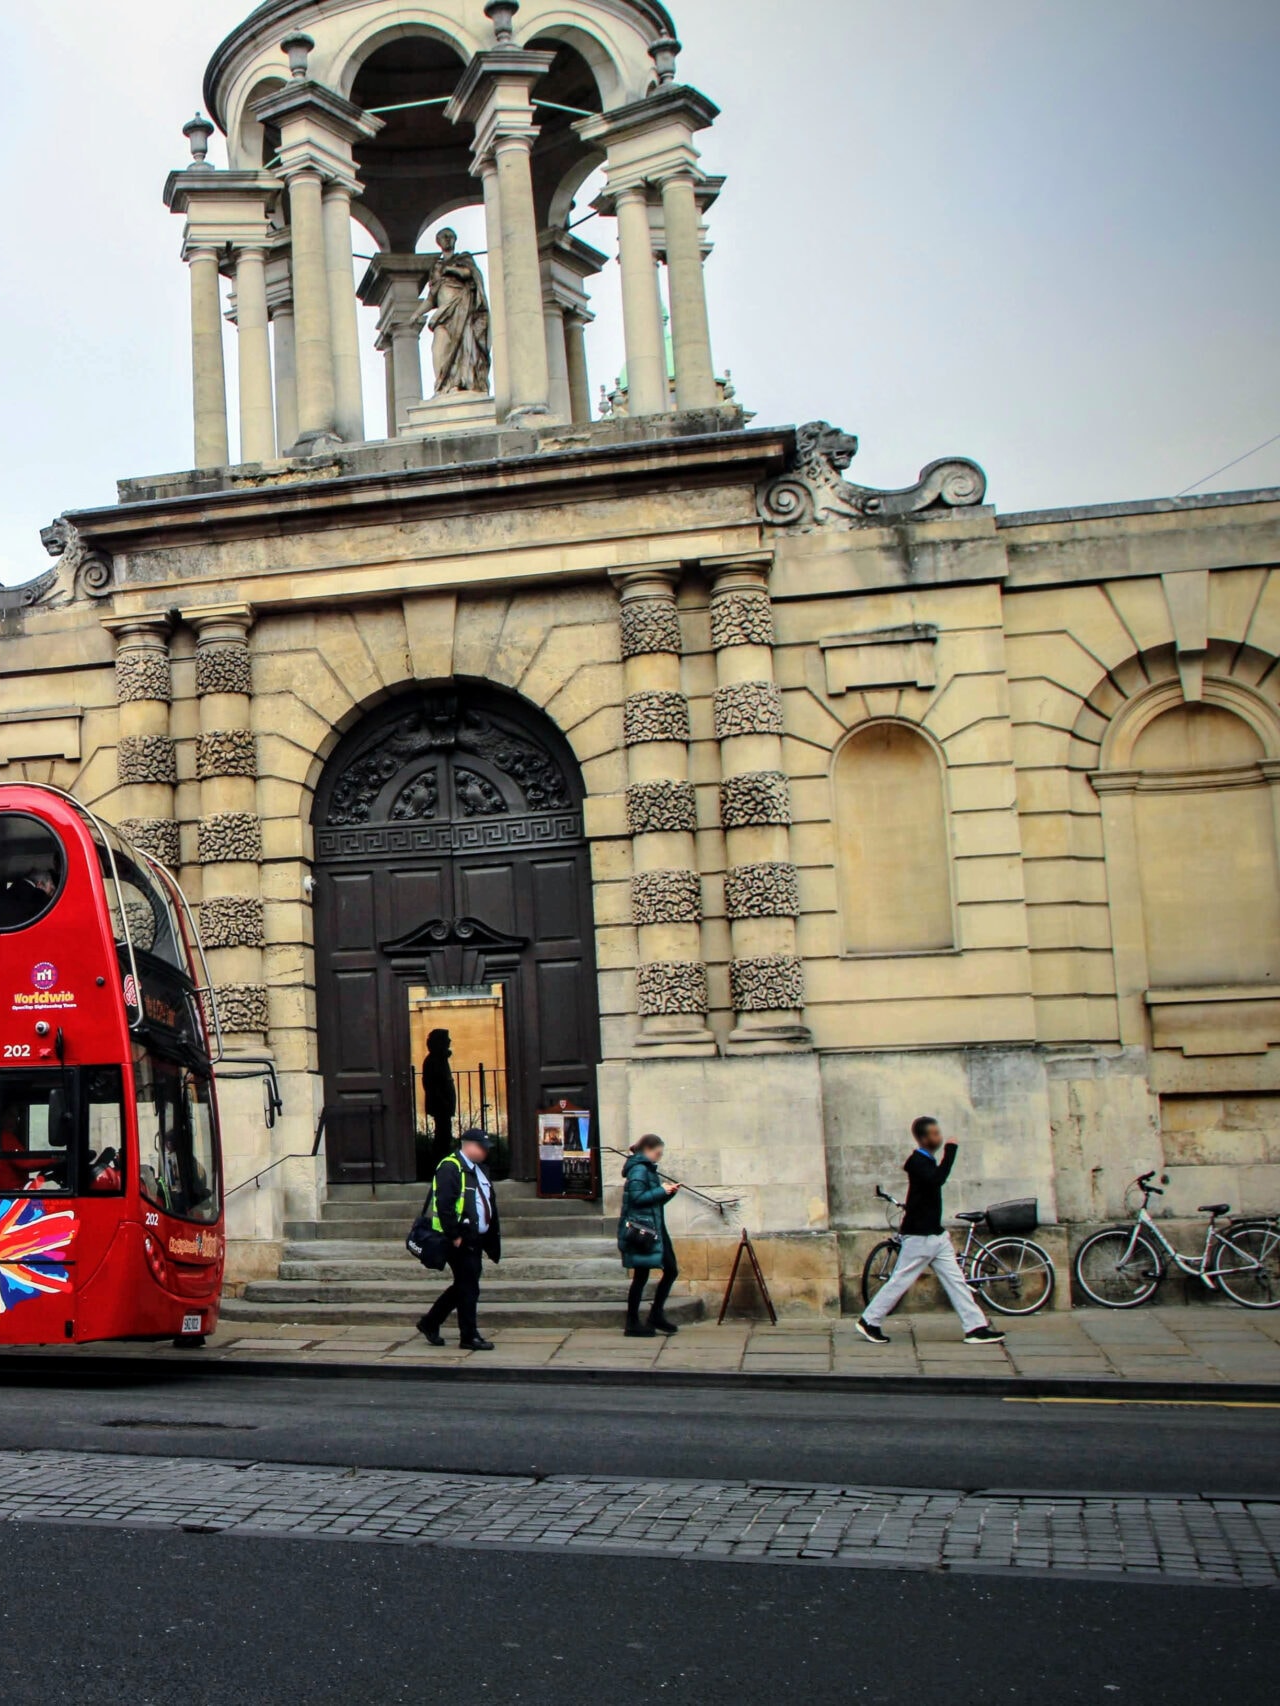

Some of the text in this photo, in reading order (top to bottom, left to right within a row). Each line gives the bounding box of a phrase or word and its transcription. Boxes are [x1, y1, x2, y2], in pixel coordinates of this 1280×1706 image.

[14, 991, 74, 1004] Worldwide
[3, 1044, 31, 1057] 202
[145, 1212, 159, 1226] 202
